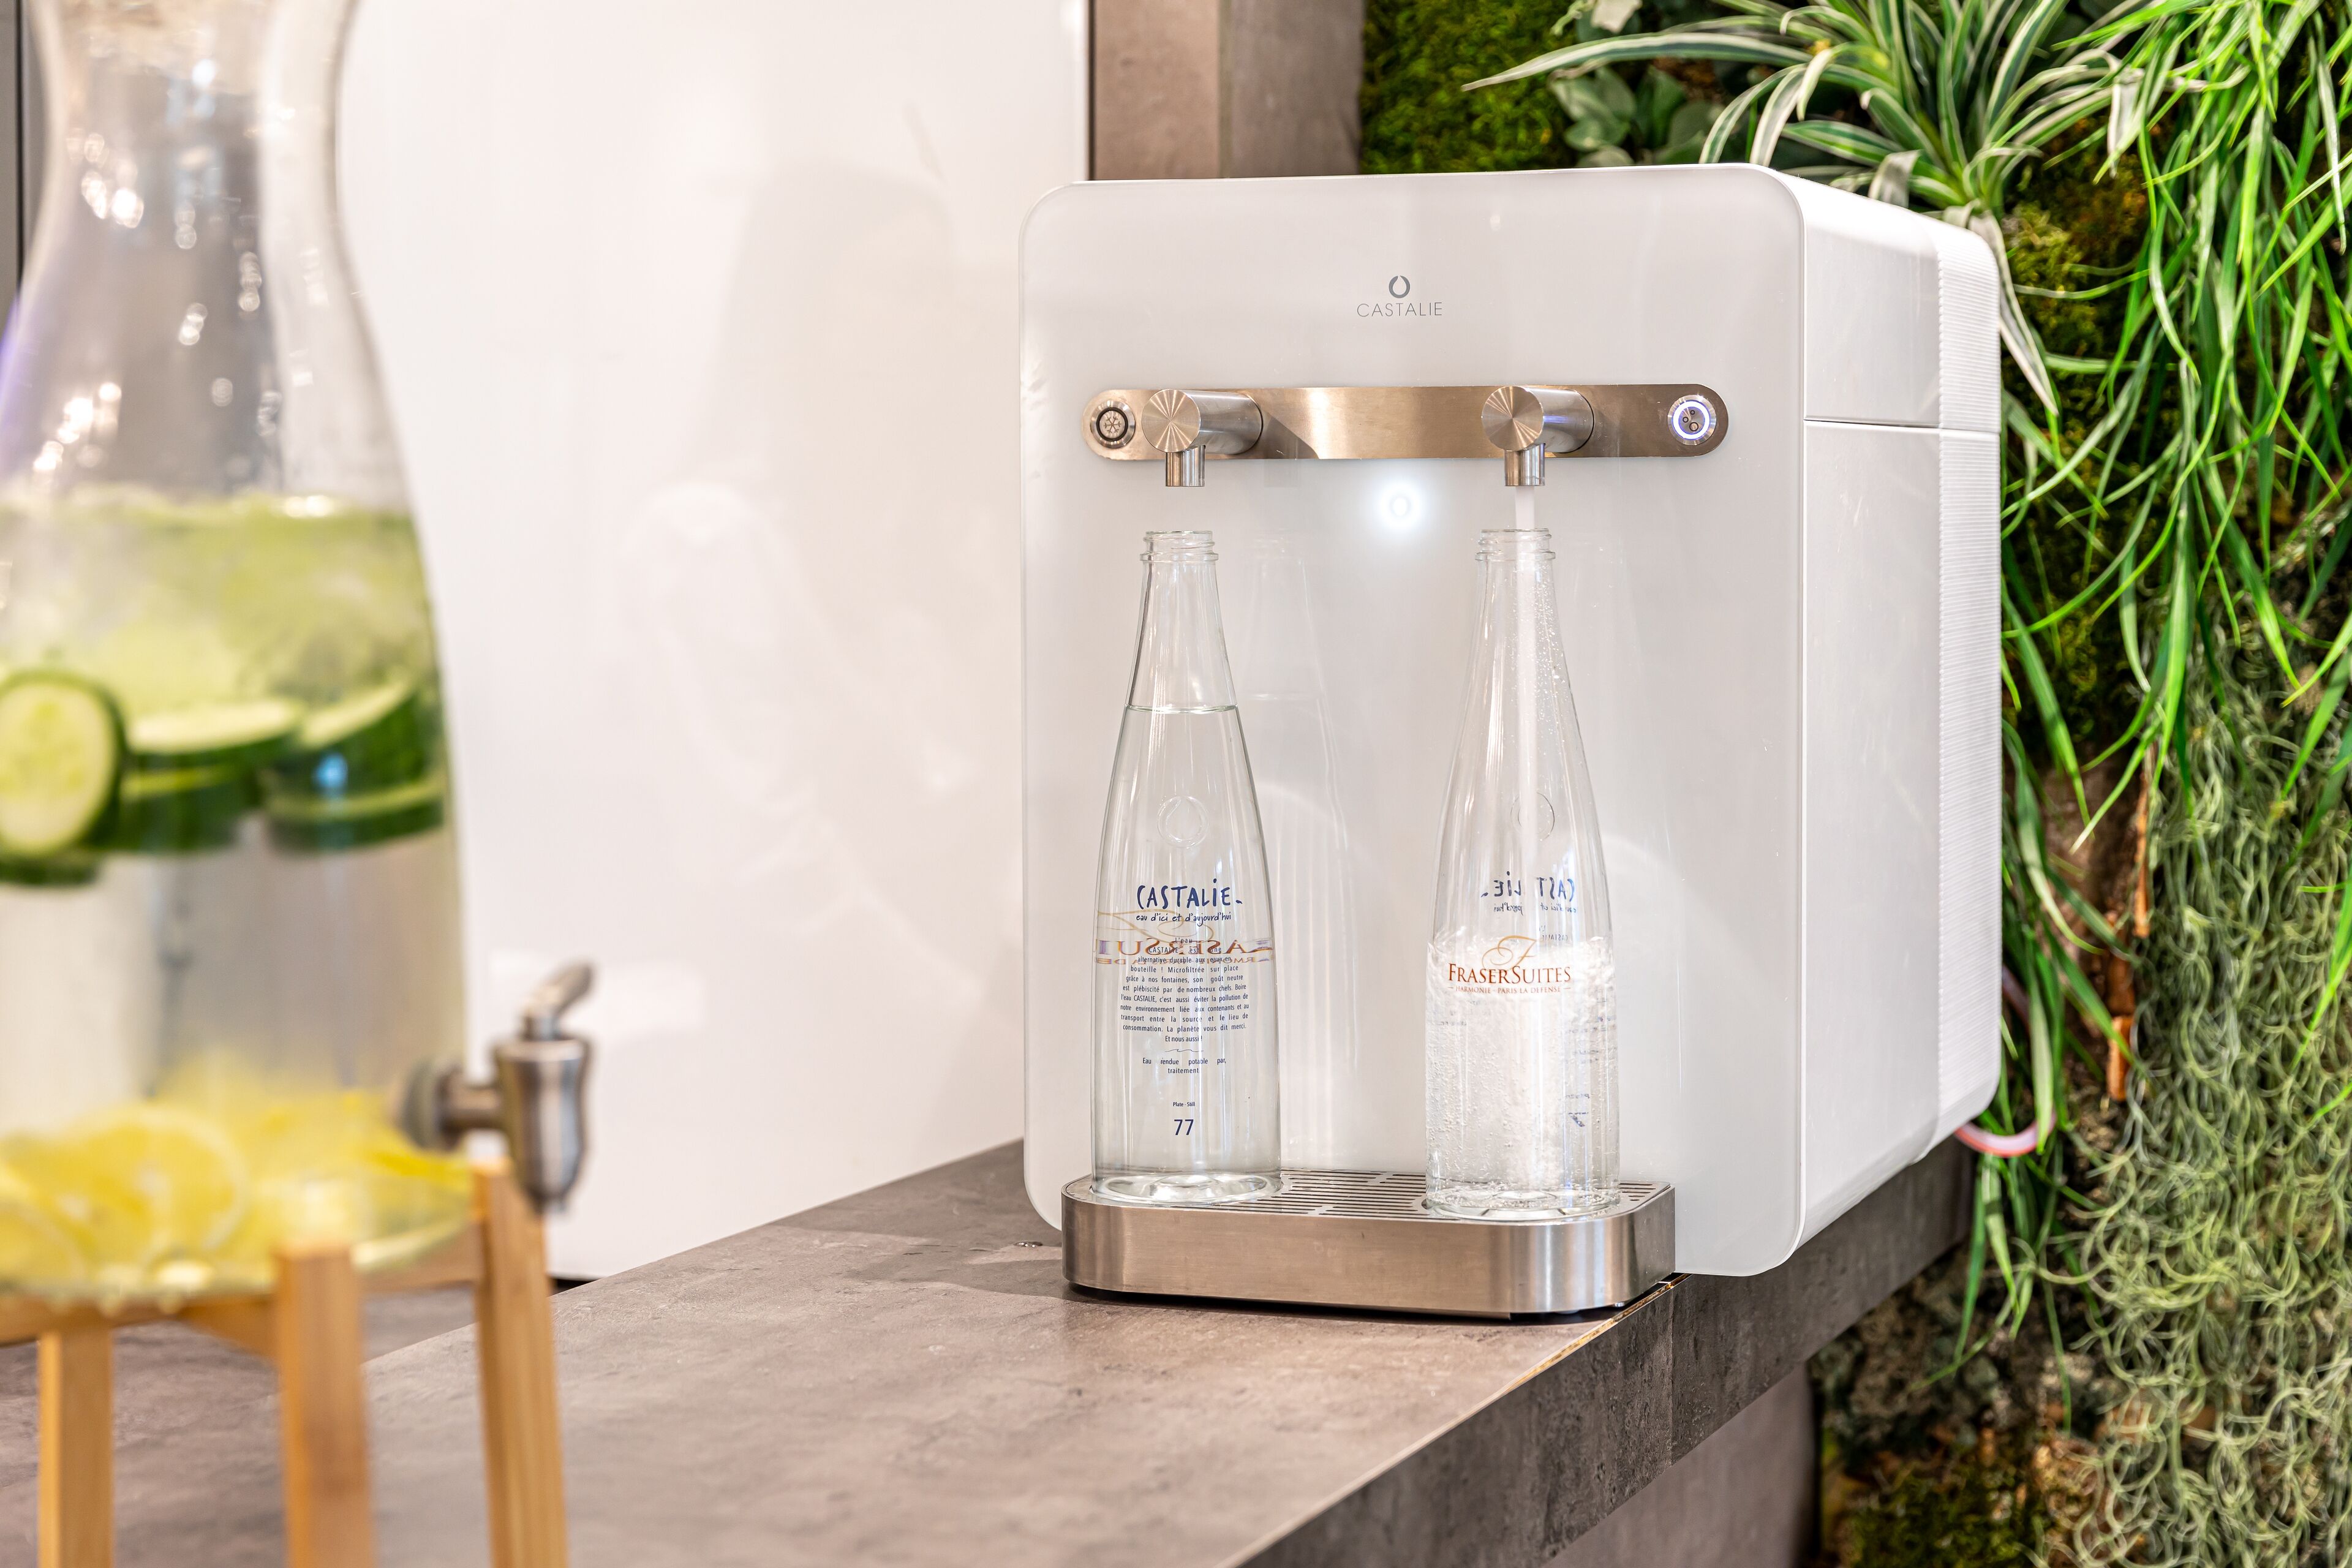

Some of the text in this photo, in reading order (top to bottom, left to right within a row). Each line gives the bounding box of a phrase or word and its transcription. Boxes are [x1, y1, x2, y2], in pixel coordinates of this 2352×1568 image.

[1357, 302, 1442, 317] CASTALIE
[1185, 911, 1231, 926] d'aujourd'hui
[1219, 994, 1240, 1003] pollution
[1177, 1025, 1199, 1033] planète
[1174, 1119, 1194, 1135] 77
